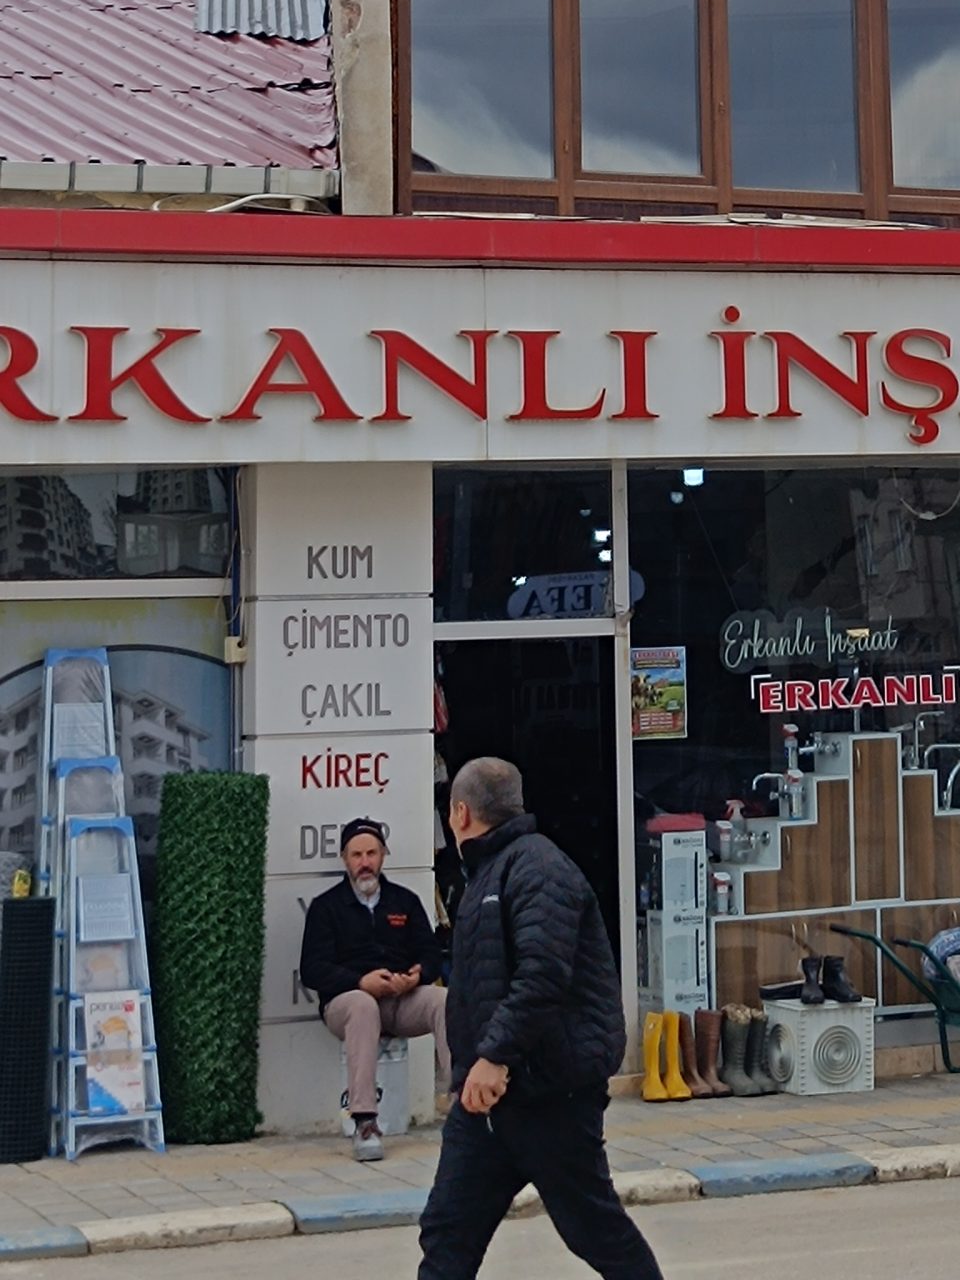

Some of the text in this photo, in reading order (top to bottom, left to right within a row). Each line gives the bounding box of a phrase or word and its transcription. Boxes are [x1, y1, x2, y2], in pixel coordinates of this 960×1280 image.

[307, 545, 373, 580] KUM
[282, 609, 410, 657] ÇİMENTO
[724, 617, 815, 668] Erkanlı
[301, 682, 392, 726] ÇAKIL
[759, 673, 956, 714] ERKANLI
[301, 747, 390, 794] KİREÇ
